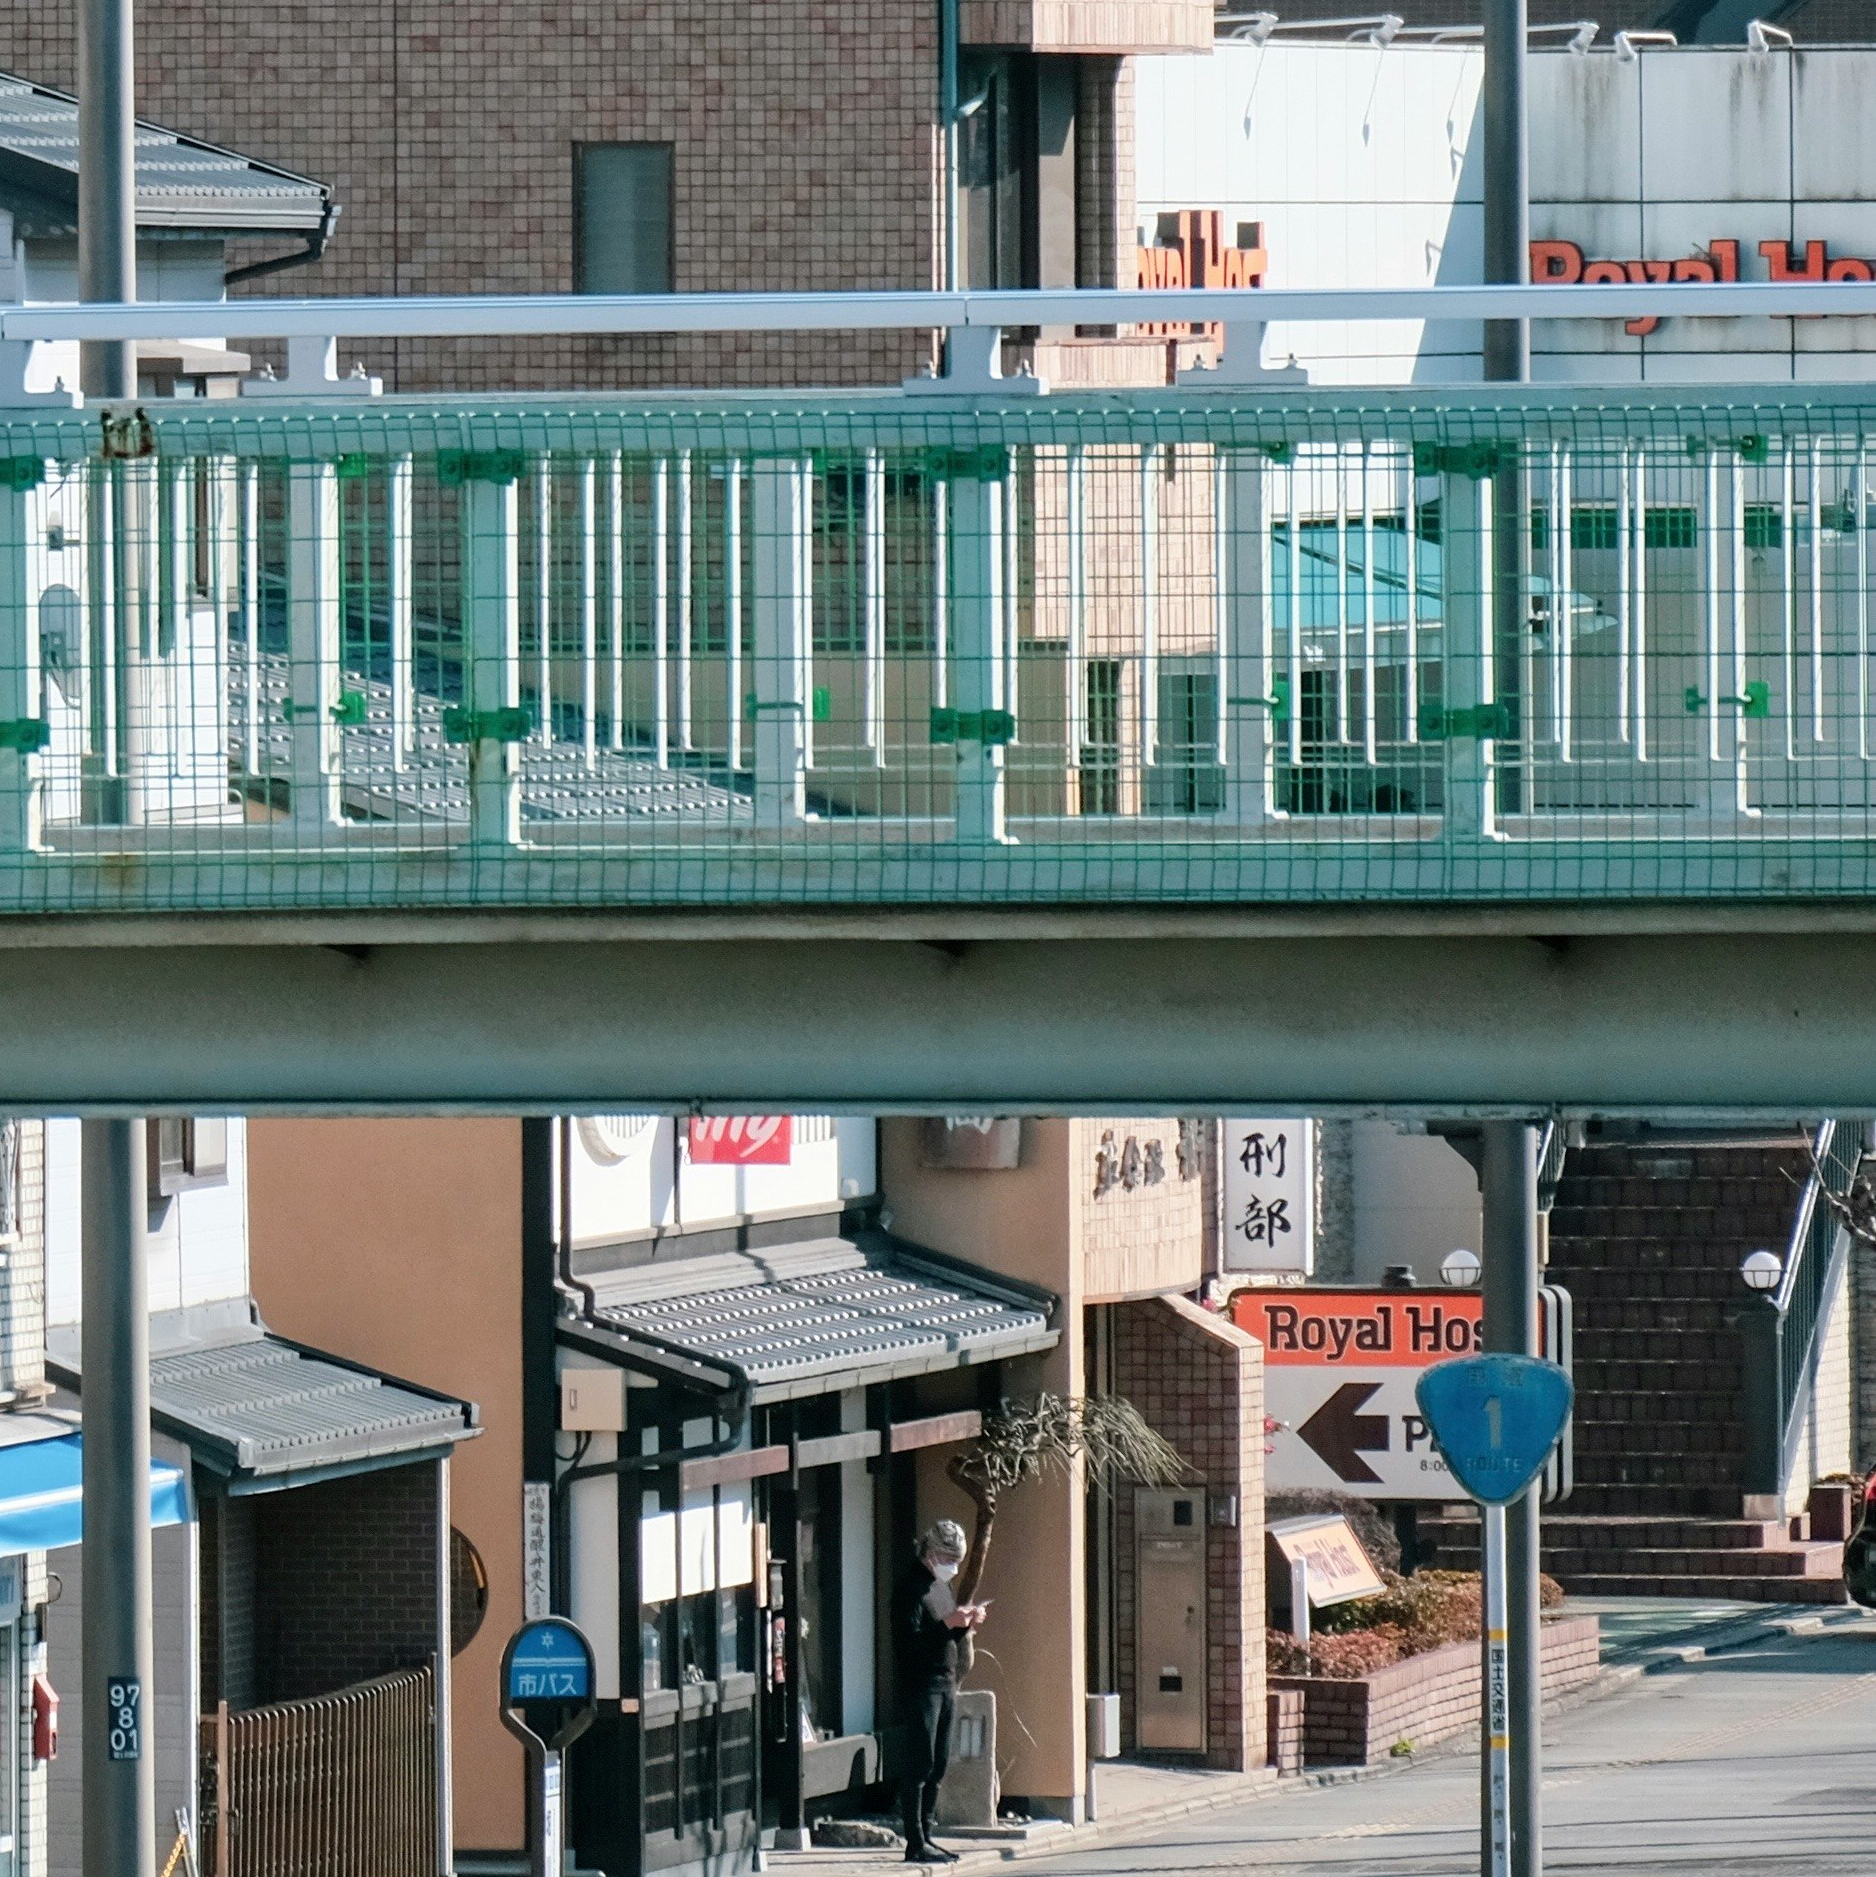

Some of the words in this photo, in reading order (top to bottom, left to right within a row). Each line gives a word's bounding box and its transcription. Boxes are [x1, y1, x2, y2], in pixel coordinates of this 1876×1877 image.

[1235, 1132, 1292, 1248] 刑部
[1264, 1304, 1392, 1360] Royal
[1405, 1306, 1483, 1353] Hos
[1402, 1415, 1441, 1452] P
[1482, 1395, 1502, 1450] 1
[110, 1685, 140, 1707] 97
[518, 1674, 577, 1696] 市バス
[118, 1707, 134, 1729] 8
[111, 1728, 137, 1751] 01
